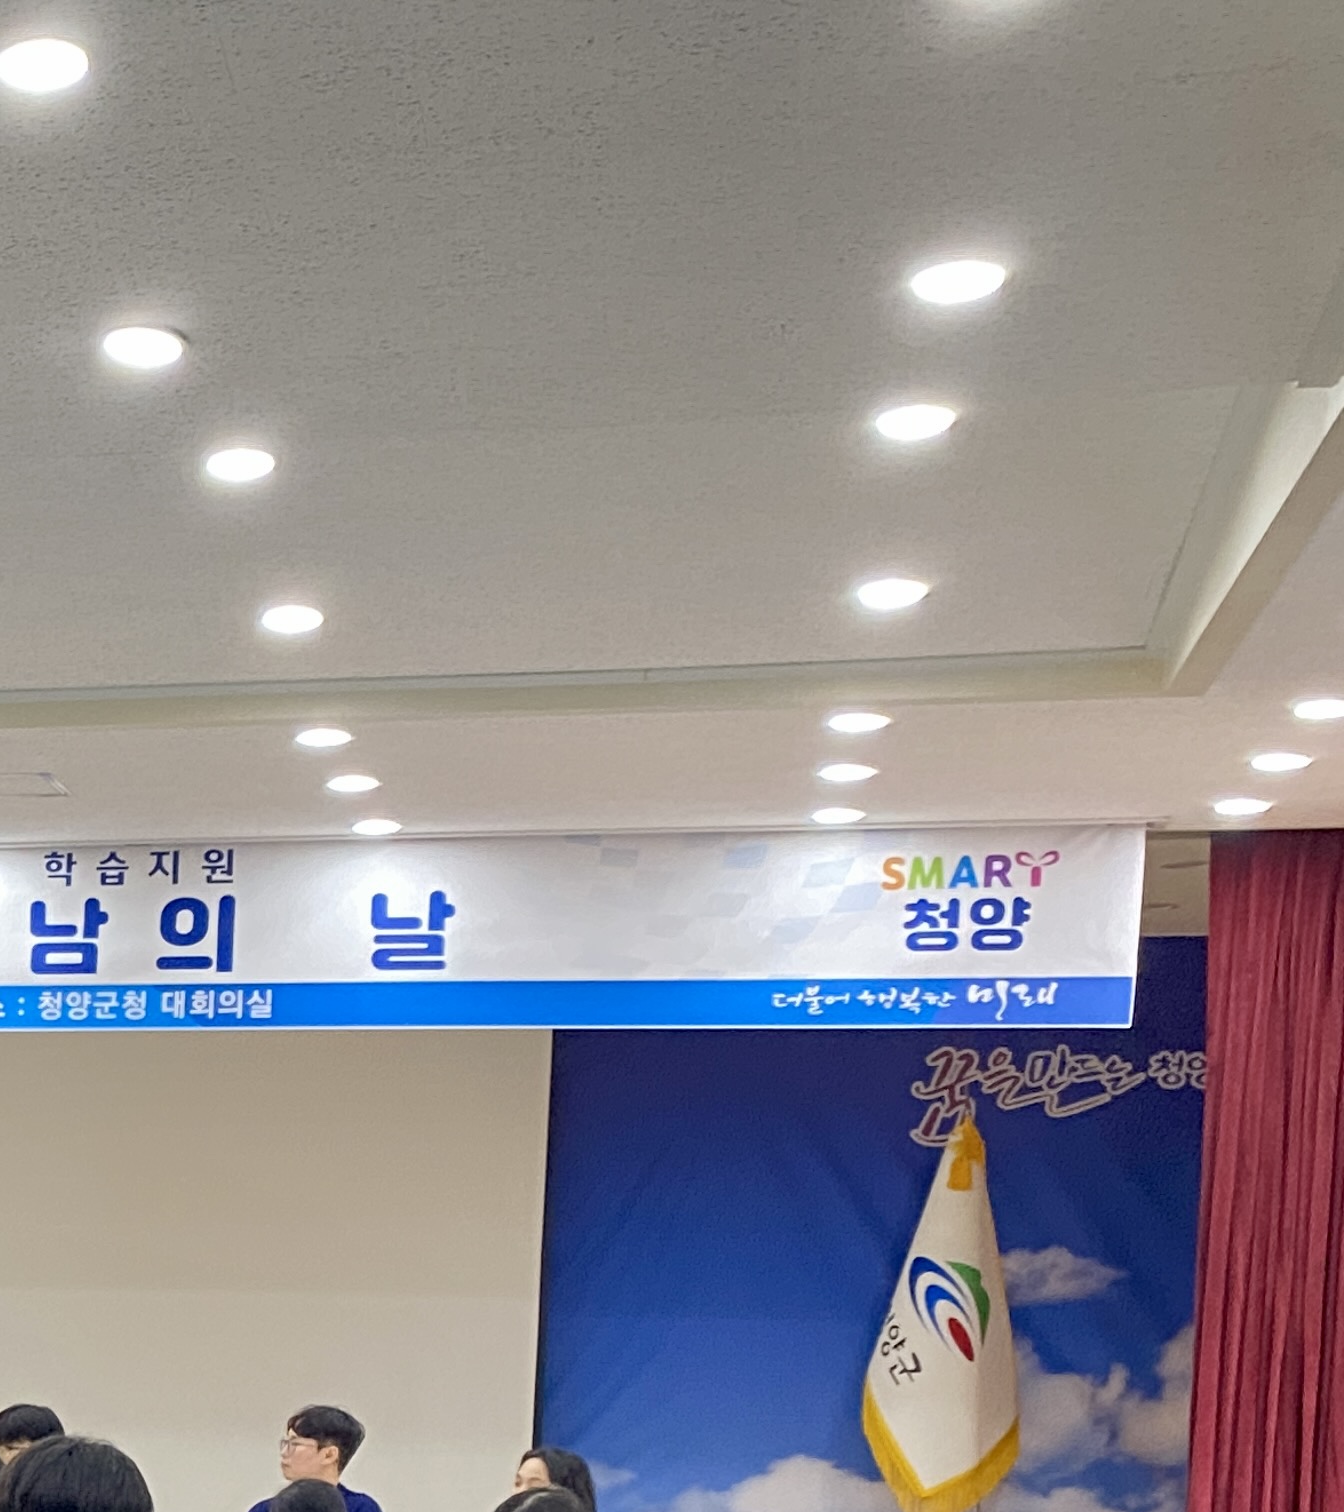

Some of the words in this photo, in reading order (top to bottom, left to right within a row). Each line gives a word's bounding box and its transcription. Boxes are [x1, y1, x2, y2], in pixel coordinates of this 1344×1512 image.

[44, 848, 236, 887] 학습지원
[880, 850, 1061, 891] SMART
[370, 889, 456, 971] 날
[903, 896, 1032, 952] 청양
[37, 991, 148, 1022] 청양군청
[161, 989, 274, 1021] 대회의실
[770, 985, 850, 1015] 더불어
[856, 983, 957, 1014] 행복한
[967, 980, 1059, 1021] 미래
[881, 1312, 923, 1387] 양군
